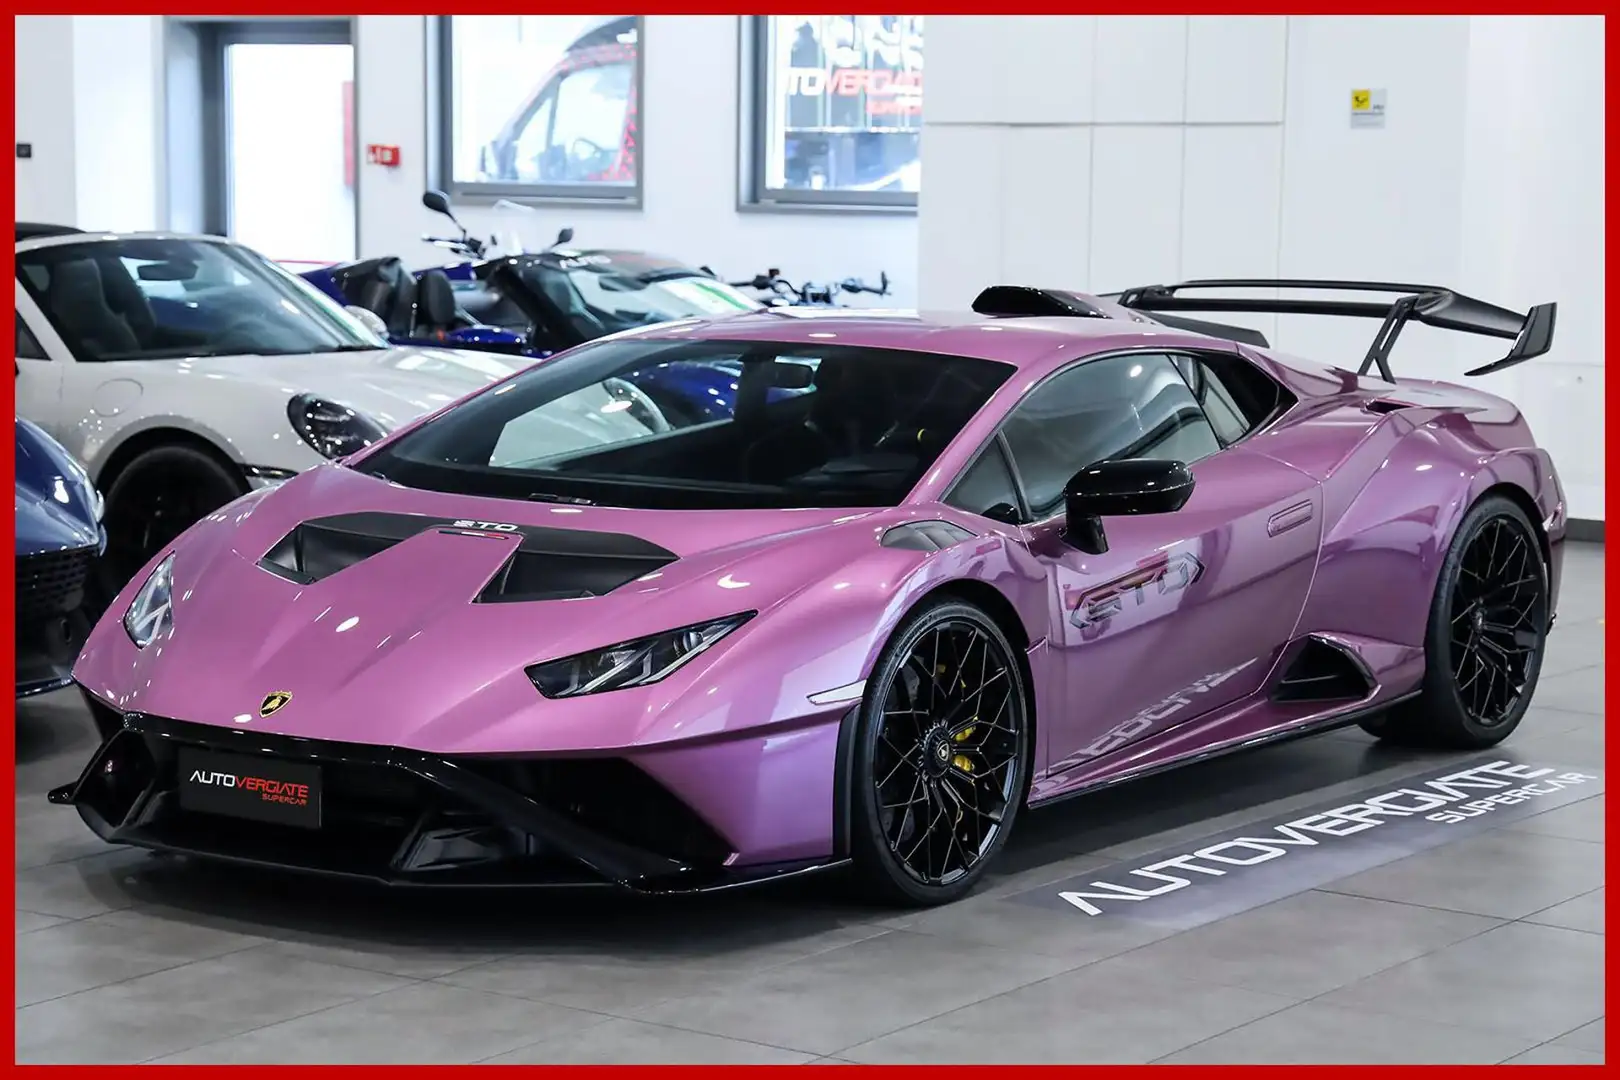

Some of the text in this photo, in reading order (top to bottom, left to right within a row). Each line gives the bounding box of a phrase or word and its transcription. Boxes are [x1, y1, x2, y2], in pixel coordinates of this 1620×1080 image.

[453, 520, 518, 532] STO
[1086, 558, 1190, 623] STO
[189, 769, 309, 798] AUTOVERGIATE
[262, 793, 307, 806] SUPERCAR
[1425, 772, 1597, 824] SUPERCAR
[1058, 760, 1556, 916] AUTOVERGIATE
